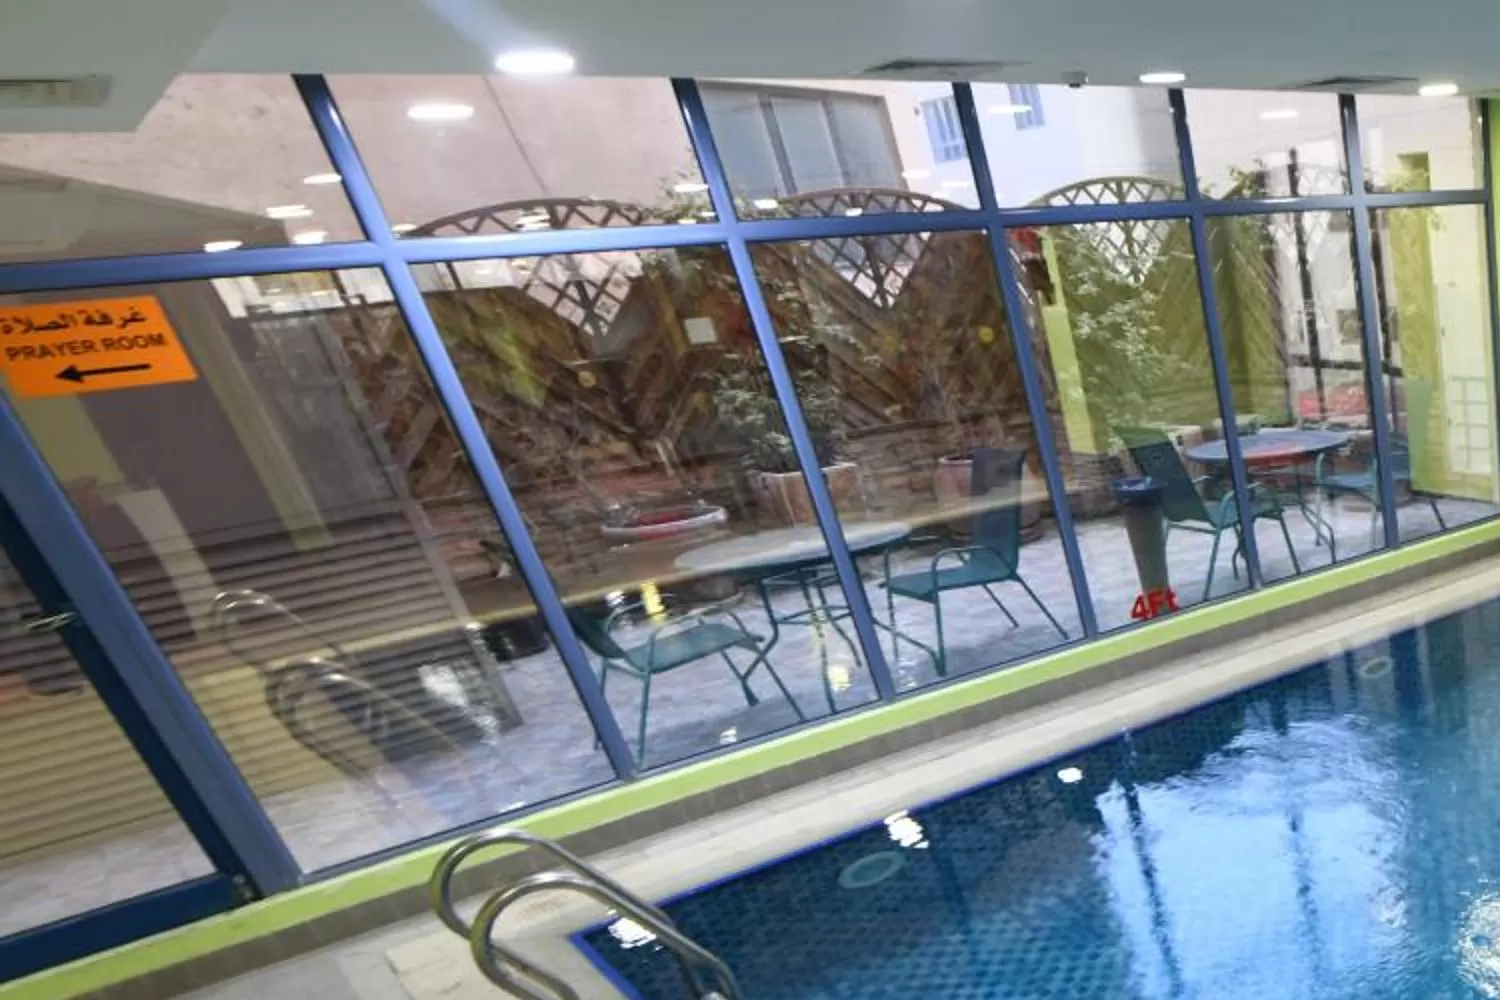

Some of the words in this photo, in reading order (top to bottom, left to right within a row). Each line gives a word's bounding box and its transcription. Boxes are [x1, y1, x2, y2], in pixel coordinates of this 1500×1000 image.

[76, 305, 148, 329] غرفة
[4, 339, 98, 362] PRAYER
[100, 332, 167, 353] ROOM
[1131, 588, 1181, 620] 4Ft
